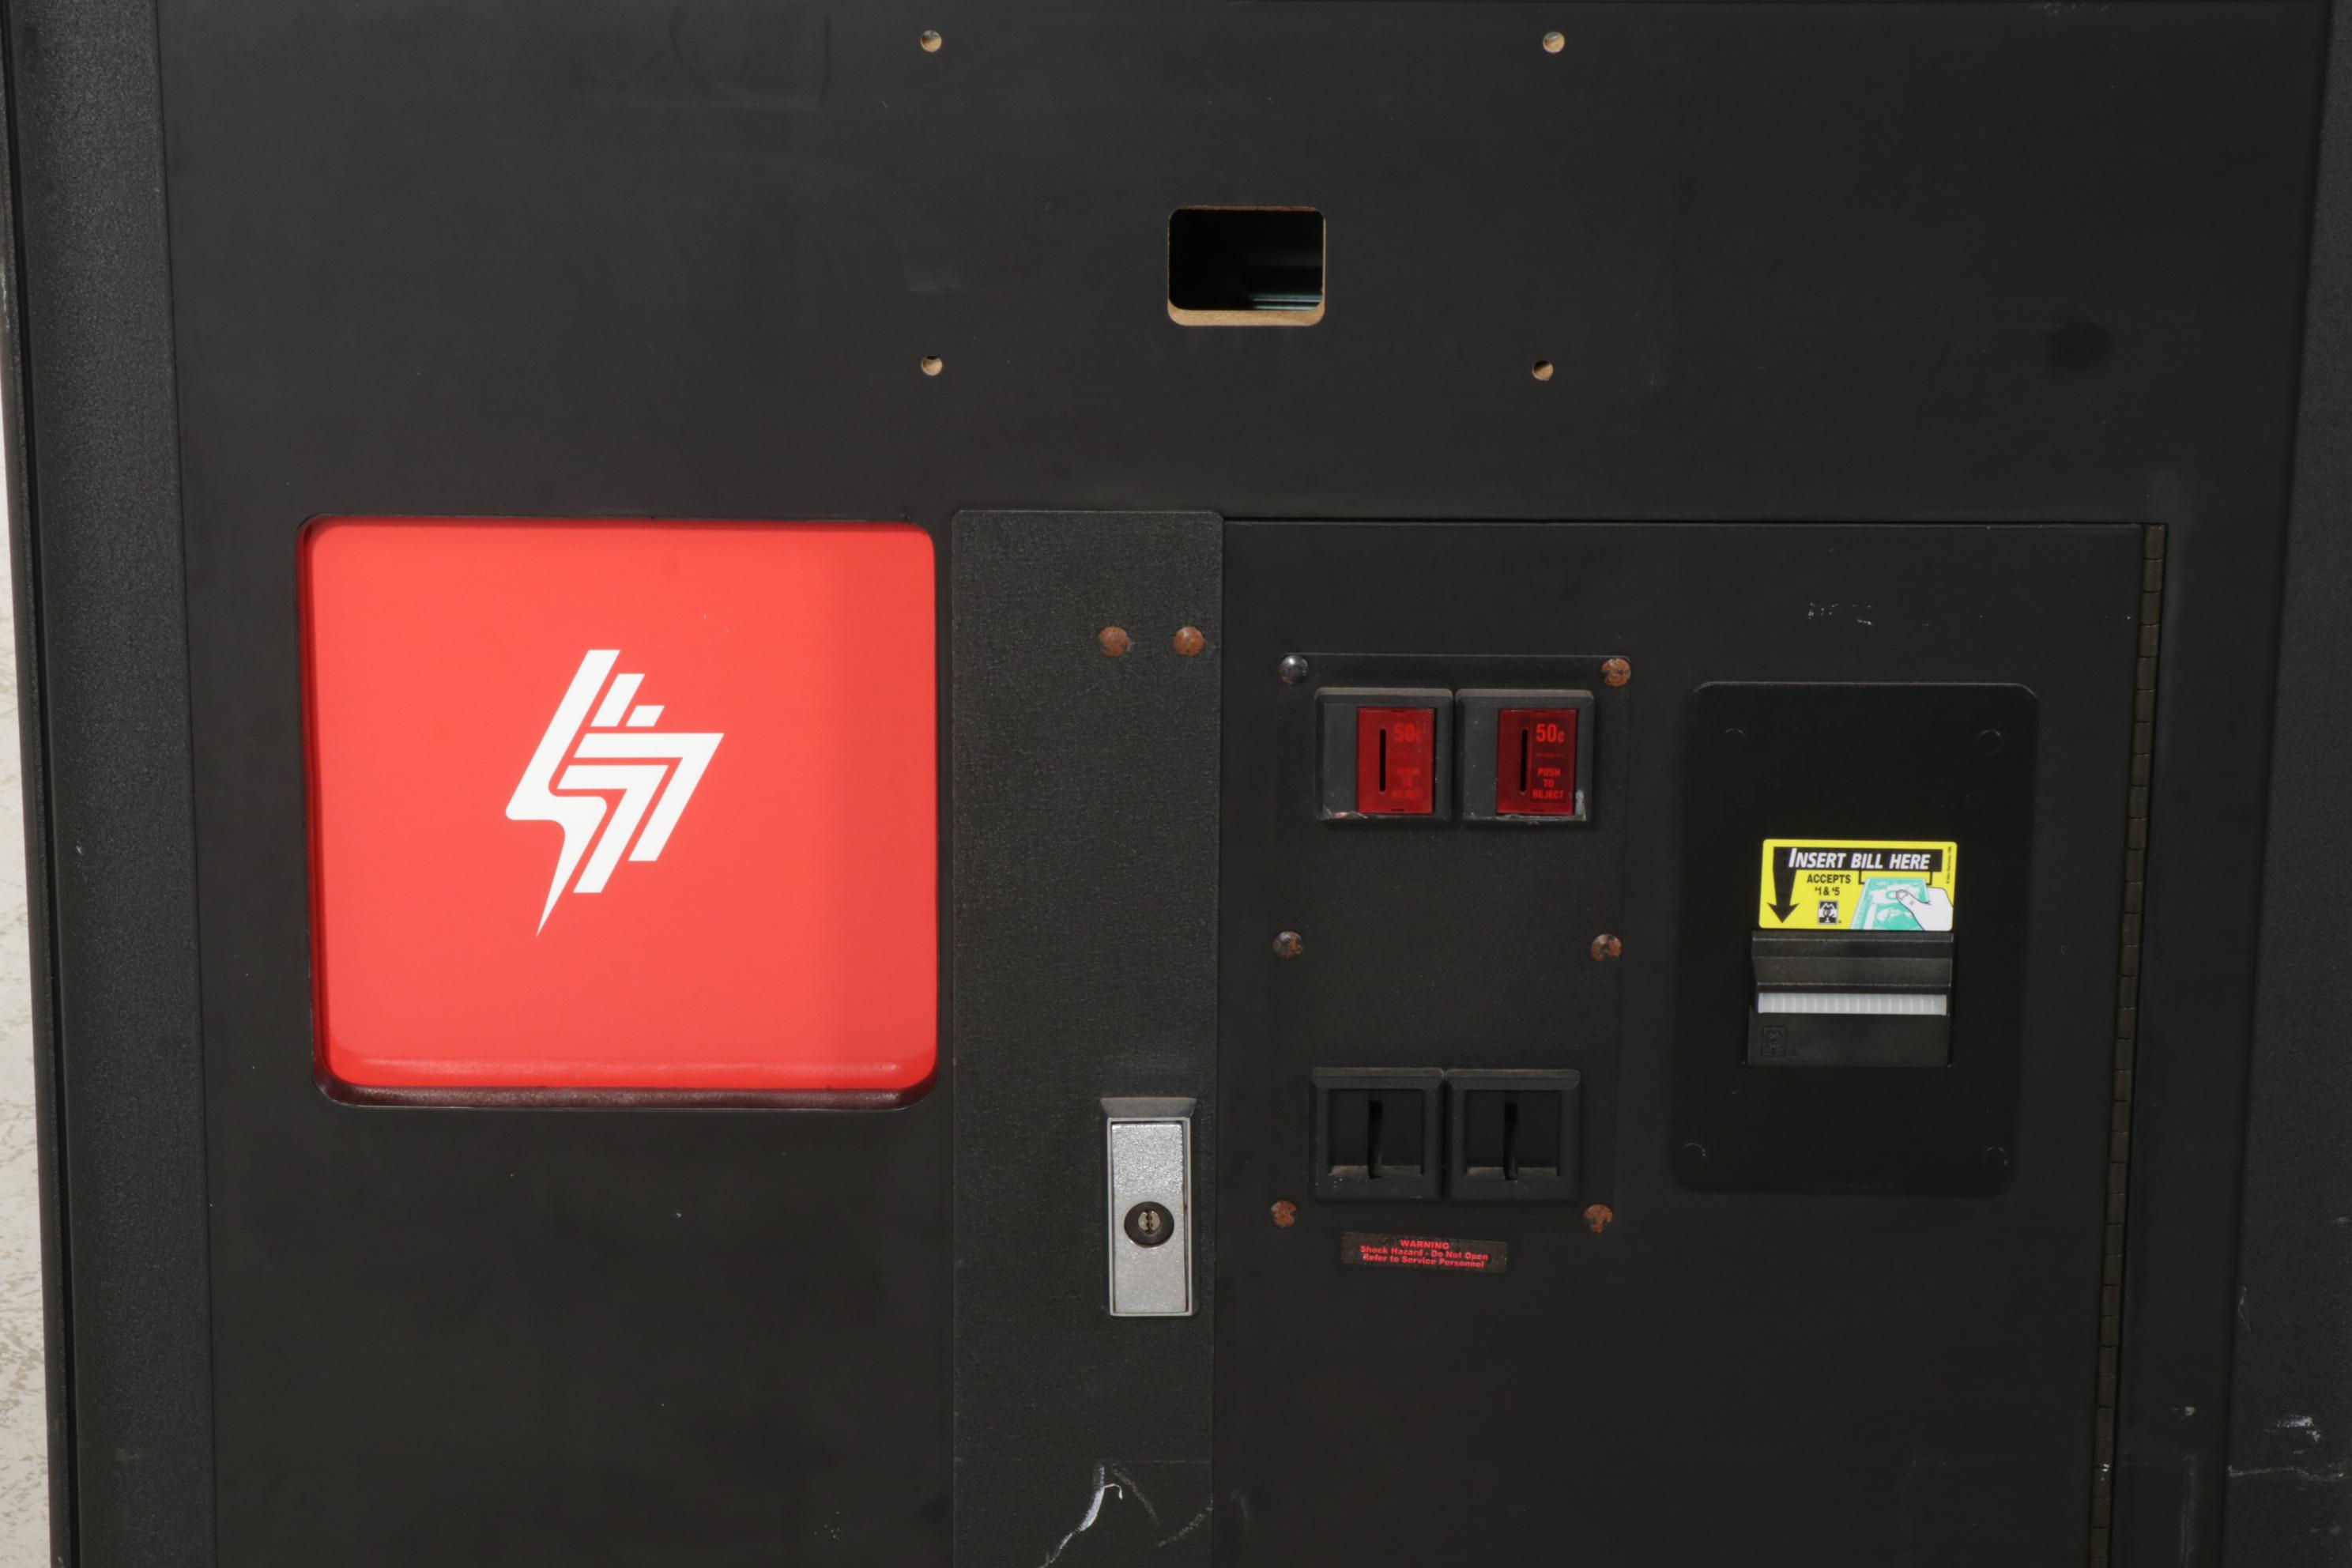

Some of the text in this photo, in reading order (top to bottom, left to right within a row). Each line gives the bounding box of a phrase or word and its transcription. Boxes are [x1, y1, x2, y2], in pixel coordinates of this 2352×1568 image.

[1536, 767, 1561, 777] PUSH
[1543, 778, 1555, 788] TO
[1532, 790, 1565, 799] REJECT
[1788, 848, 1847, 869] INSERT
[1850, 854, 1883, 870] BILL
[1889, 854, 1931, 870] HERE
[1807, 873, 1851, 884] ACCEPTS
[1400, 1239, 1449, 1250] WARNING
[1359, 1244, 1388, 1254] Shock
[1390, 1247, 1423, 1257] Hazard
[1431, 1250, 1443, 1258] Do
[1446, 1251, 1463, 1260] Not
[1464, 1252, 1489, 1261] Open
[1362, 1253, 1388, 1263] Refer
[1401, 1255, 1436, 1265] Service
[1438, 1257, 1485, 1268] Personnel
